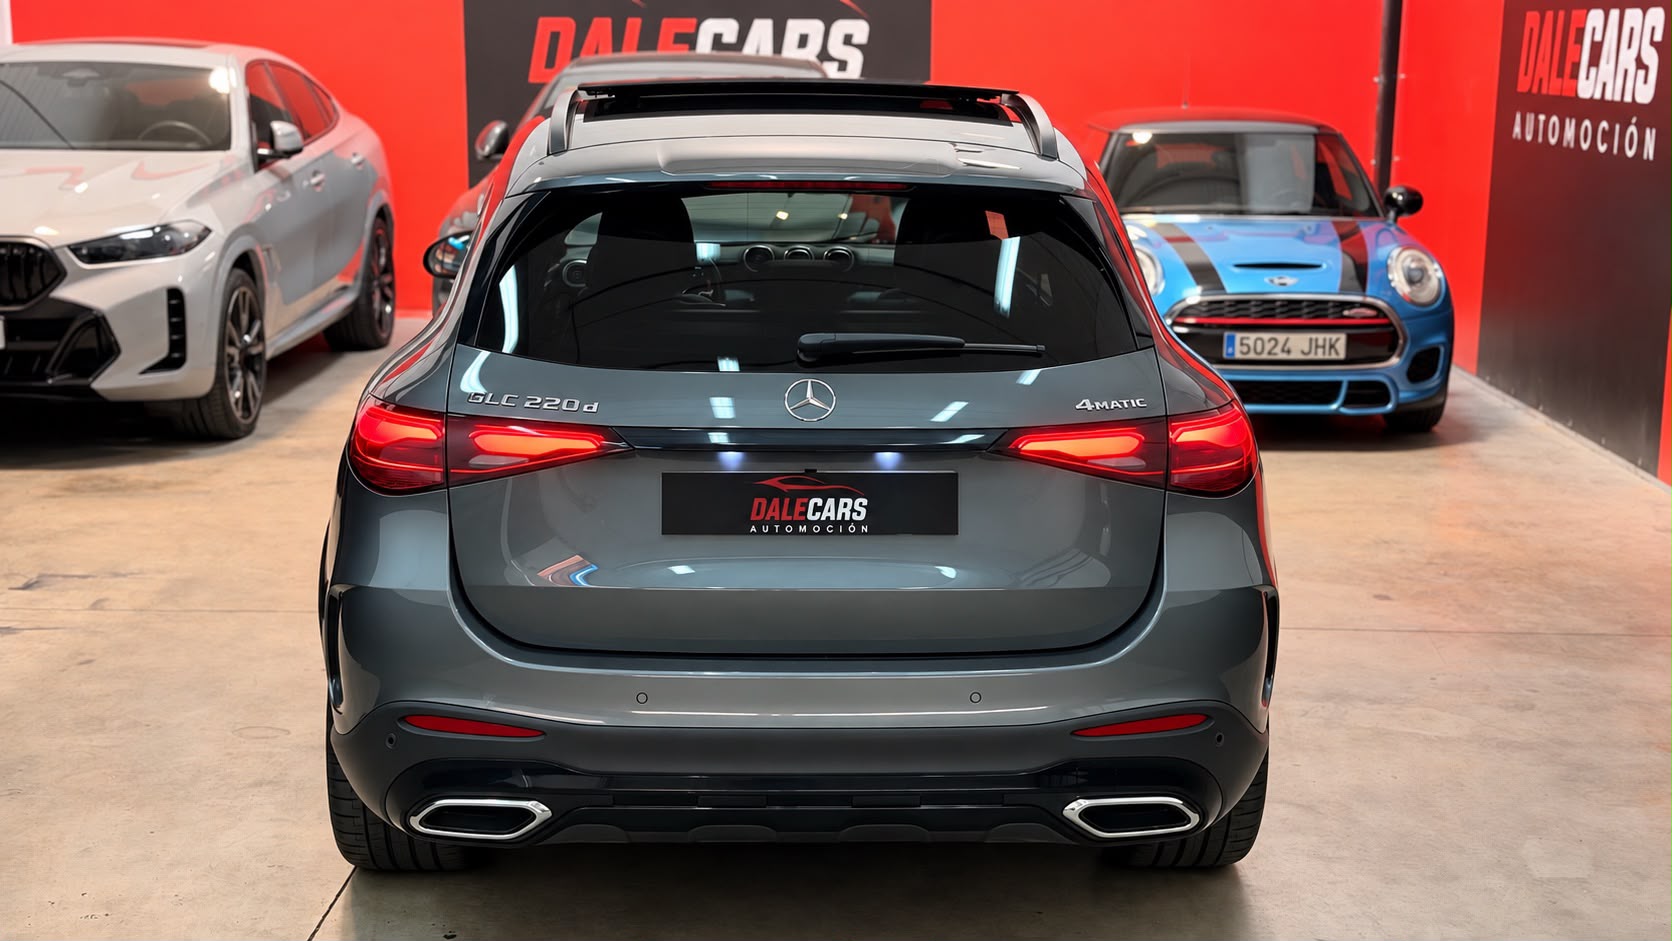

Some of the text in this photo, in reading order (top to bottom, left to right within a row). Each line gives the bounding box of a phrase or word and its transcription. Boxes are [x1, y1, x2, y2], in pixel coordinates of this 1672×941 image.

[1516, 7, 1665, 104] DALECARS
[1512, 110, 1656, 161] AUTOMOCIÓN
[1239, 337, 1342, 356] 5024 JHK
[468, 392, 518, 407] GLC
[1075, 398, 1147, 411] 4MATIC
[750, 498, 868, 520] DALECARS
[750, 523, 868, 533] AUTOMOCIÓN
